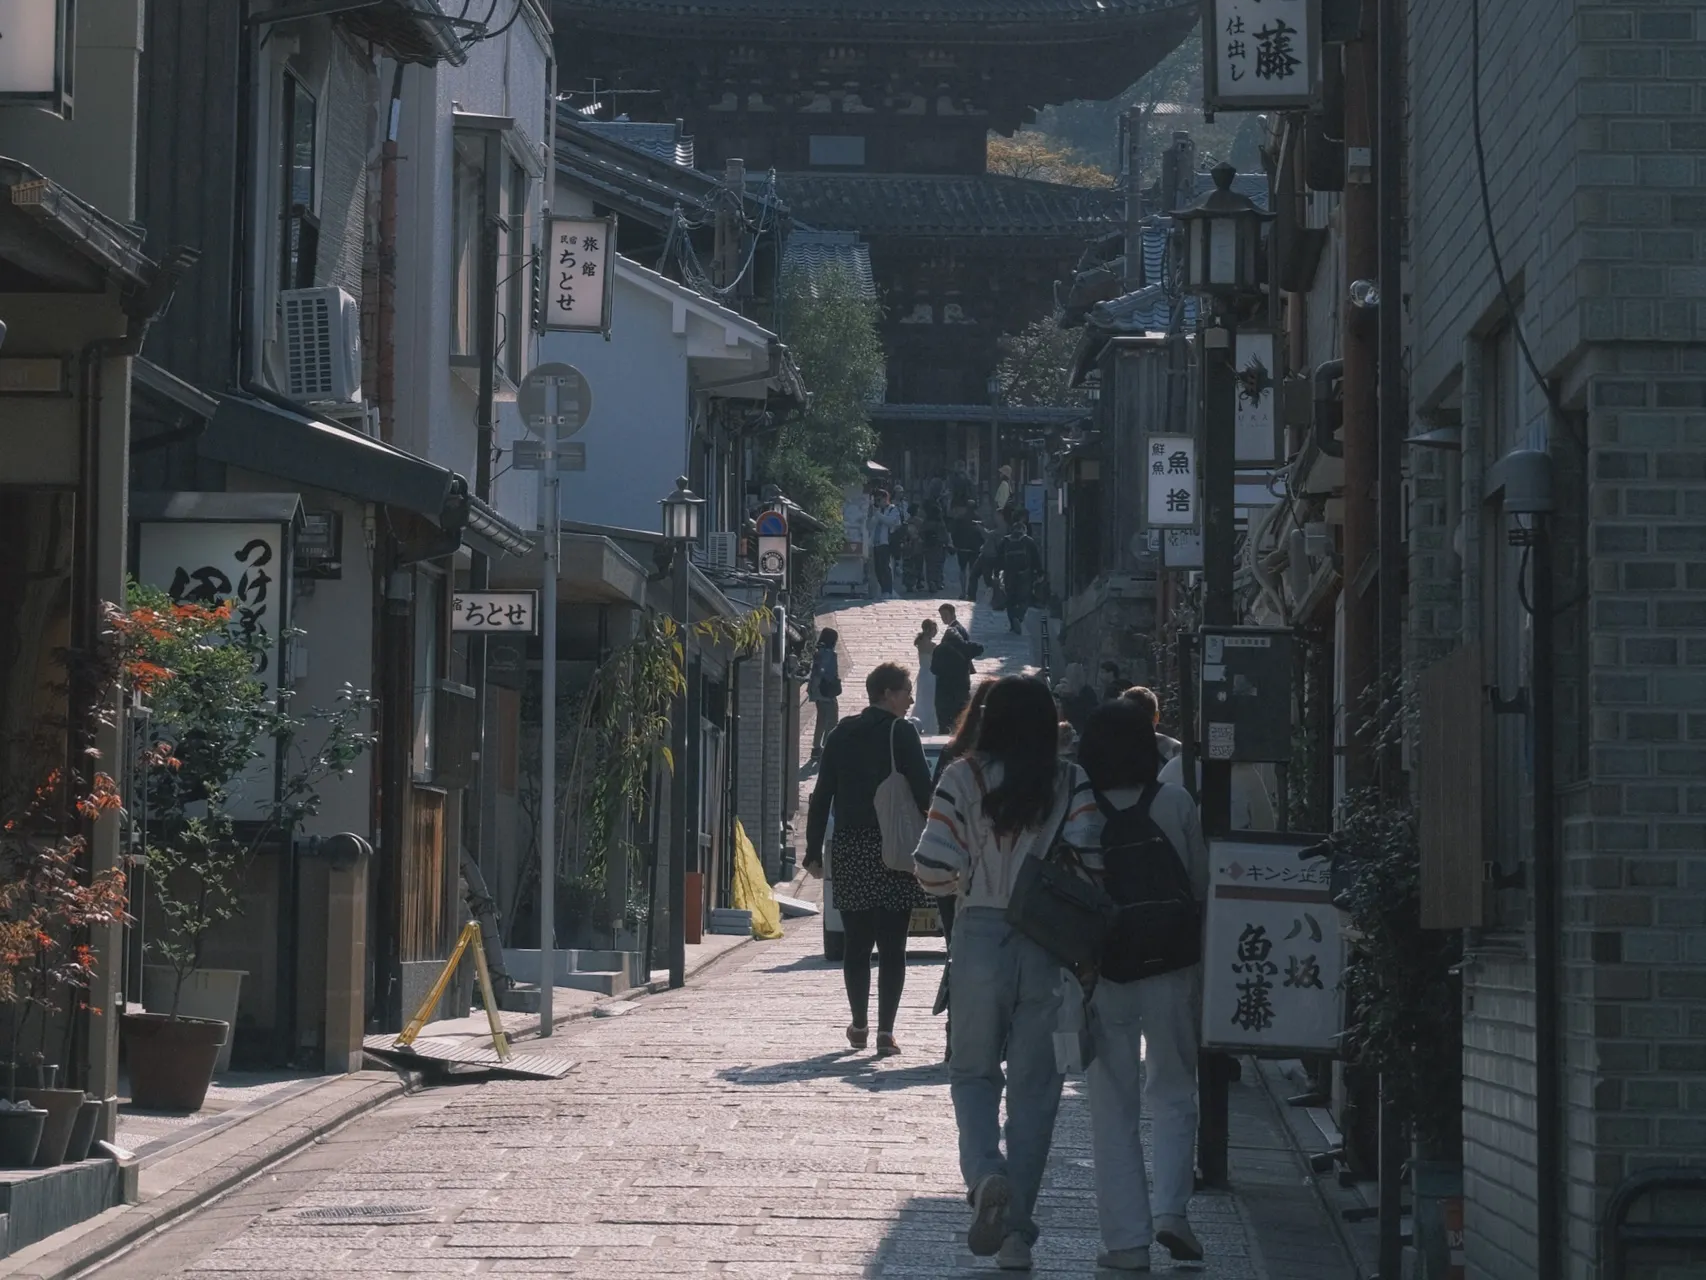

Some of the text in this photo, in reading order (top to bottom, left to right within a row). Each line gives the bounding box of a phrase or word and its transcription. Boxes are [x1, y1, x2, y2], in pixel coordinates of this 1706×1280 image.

[556, 249, 576, 311] ちとせ
[581, 236, 599, 277] 旅館
[1152, 442, 1165, 475] 鮮魚
[1231, 923, 1278, 1032] 魚藤
[1283, 912, 1324, 990] 八坂
